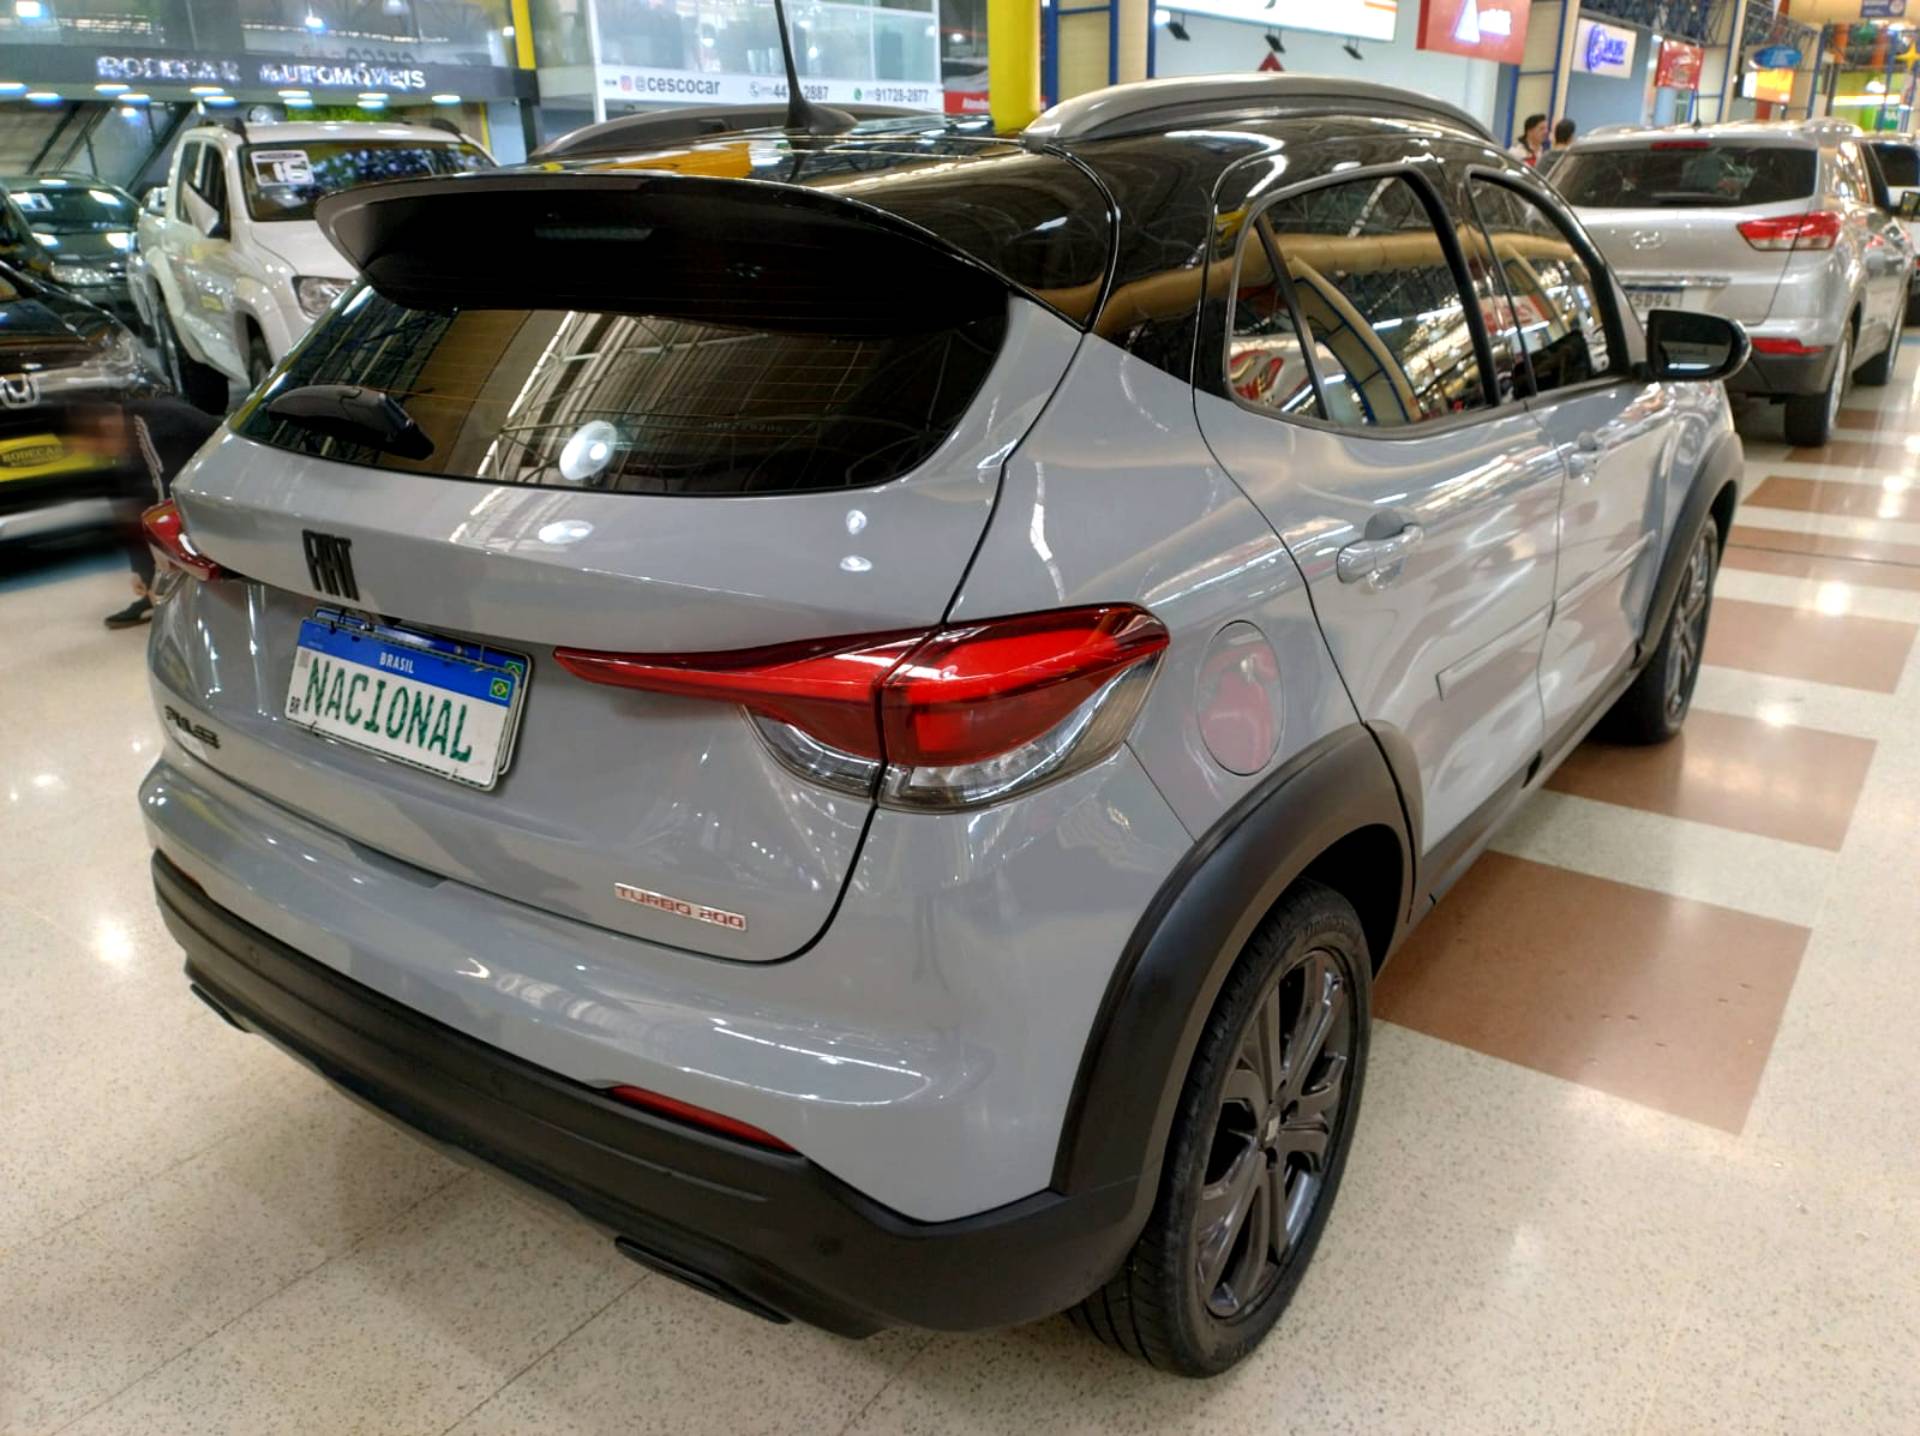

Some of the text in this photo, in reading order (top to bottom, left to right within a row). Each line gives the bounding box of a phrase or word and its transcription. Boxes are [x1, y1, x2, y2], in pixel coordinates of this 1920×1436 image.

[634, 75, 721, 95] @cescocar
[379, 652, 415, 674] BRASIL
[303, 656, 473, 763] NACIONAL
[616, 885, 744, 928] TURBO 200
